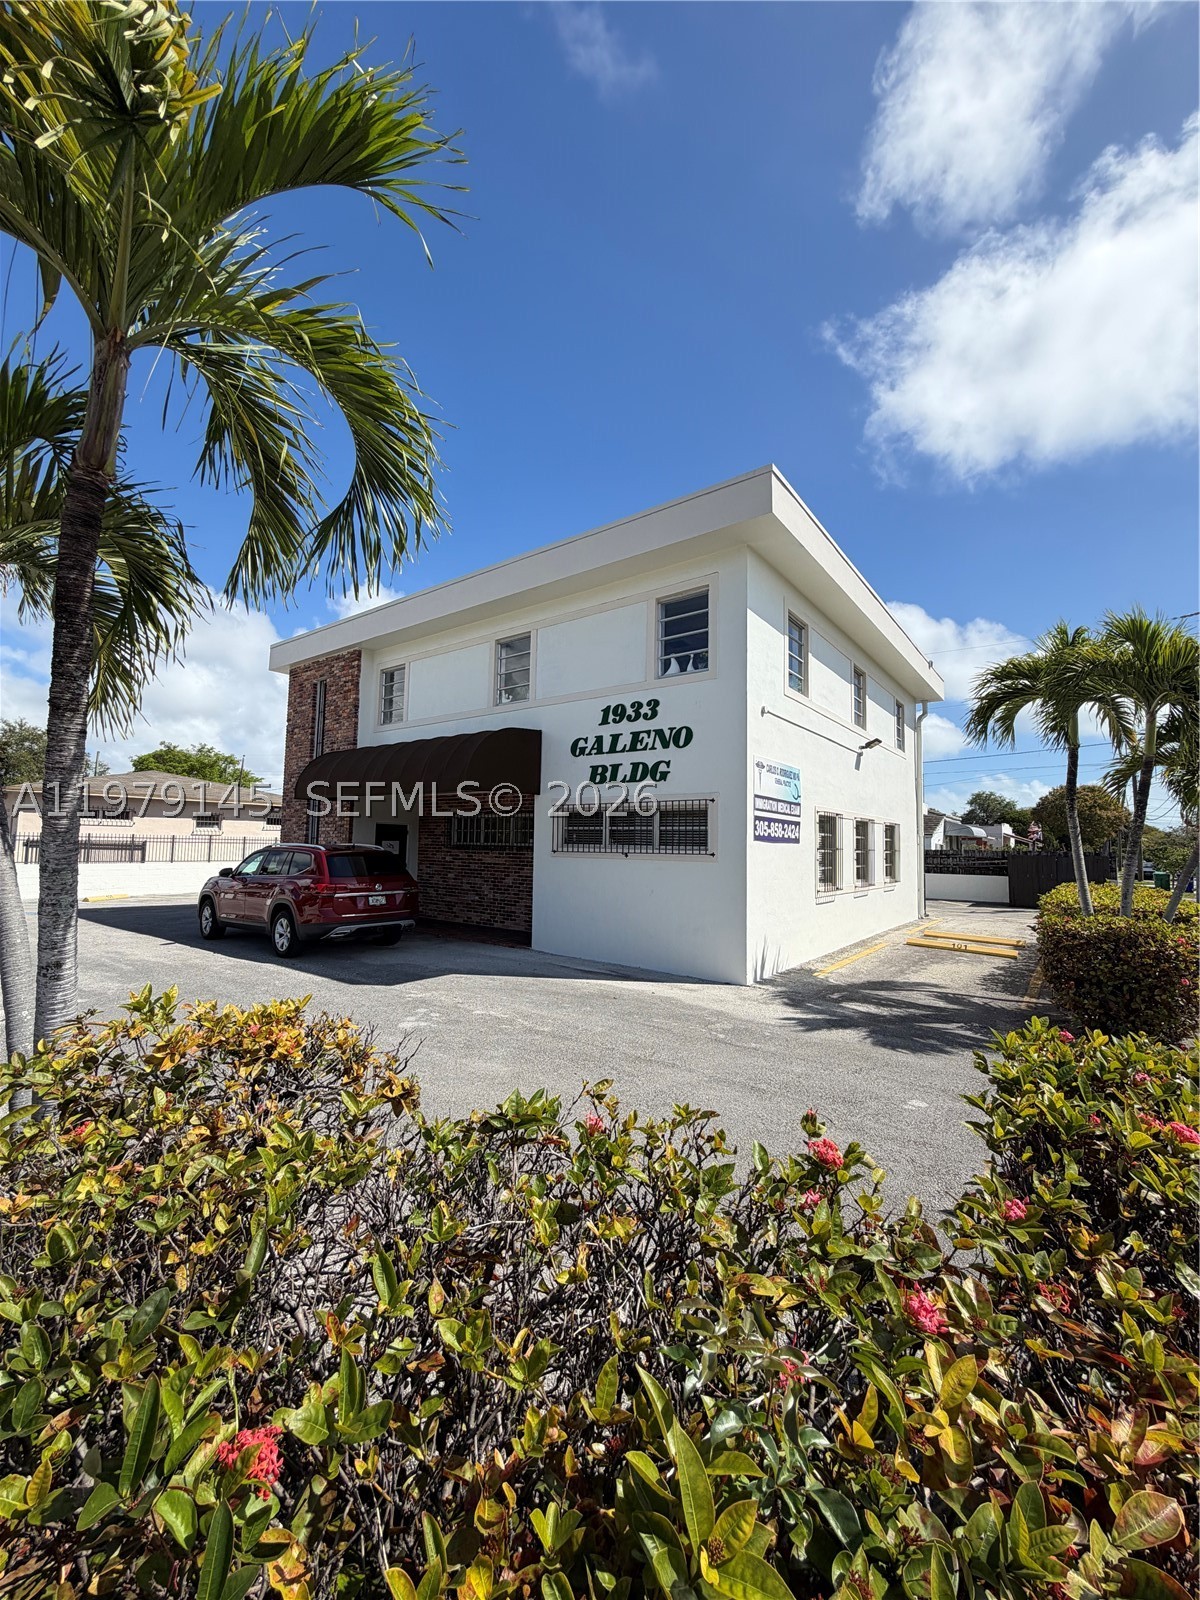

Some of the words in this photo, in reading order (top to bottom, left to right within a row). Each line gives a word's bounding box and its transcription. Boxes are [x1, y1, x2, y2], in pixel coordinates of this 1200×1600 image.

[598, 698, 660, 726] 1933
[570, 725, 693, 758] GALENO
[588, 759, 671, 785] BLDG
[754, 797, 778, 812] IMMIGRATION
[778, 801, 790, 814] MEDICAL
[755, 820, 799, 840] 305-858-2424
